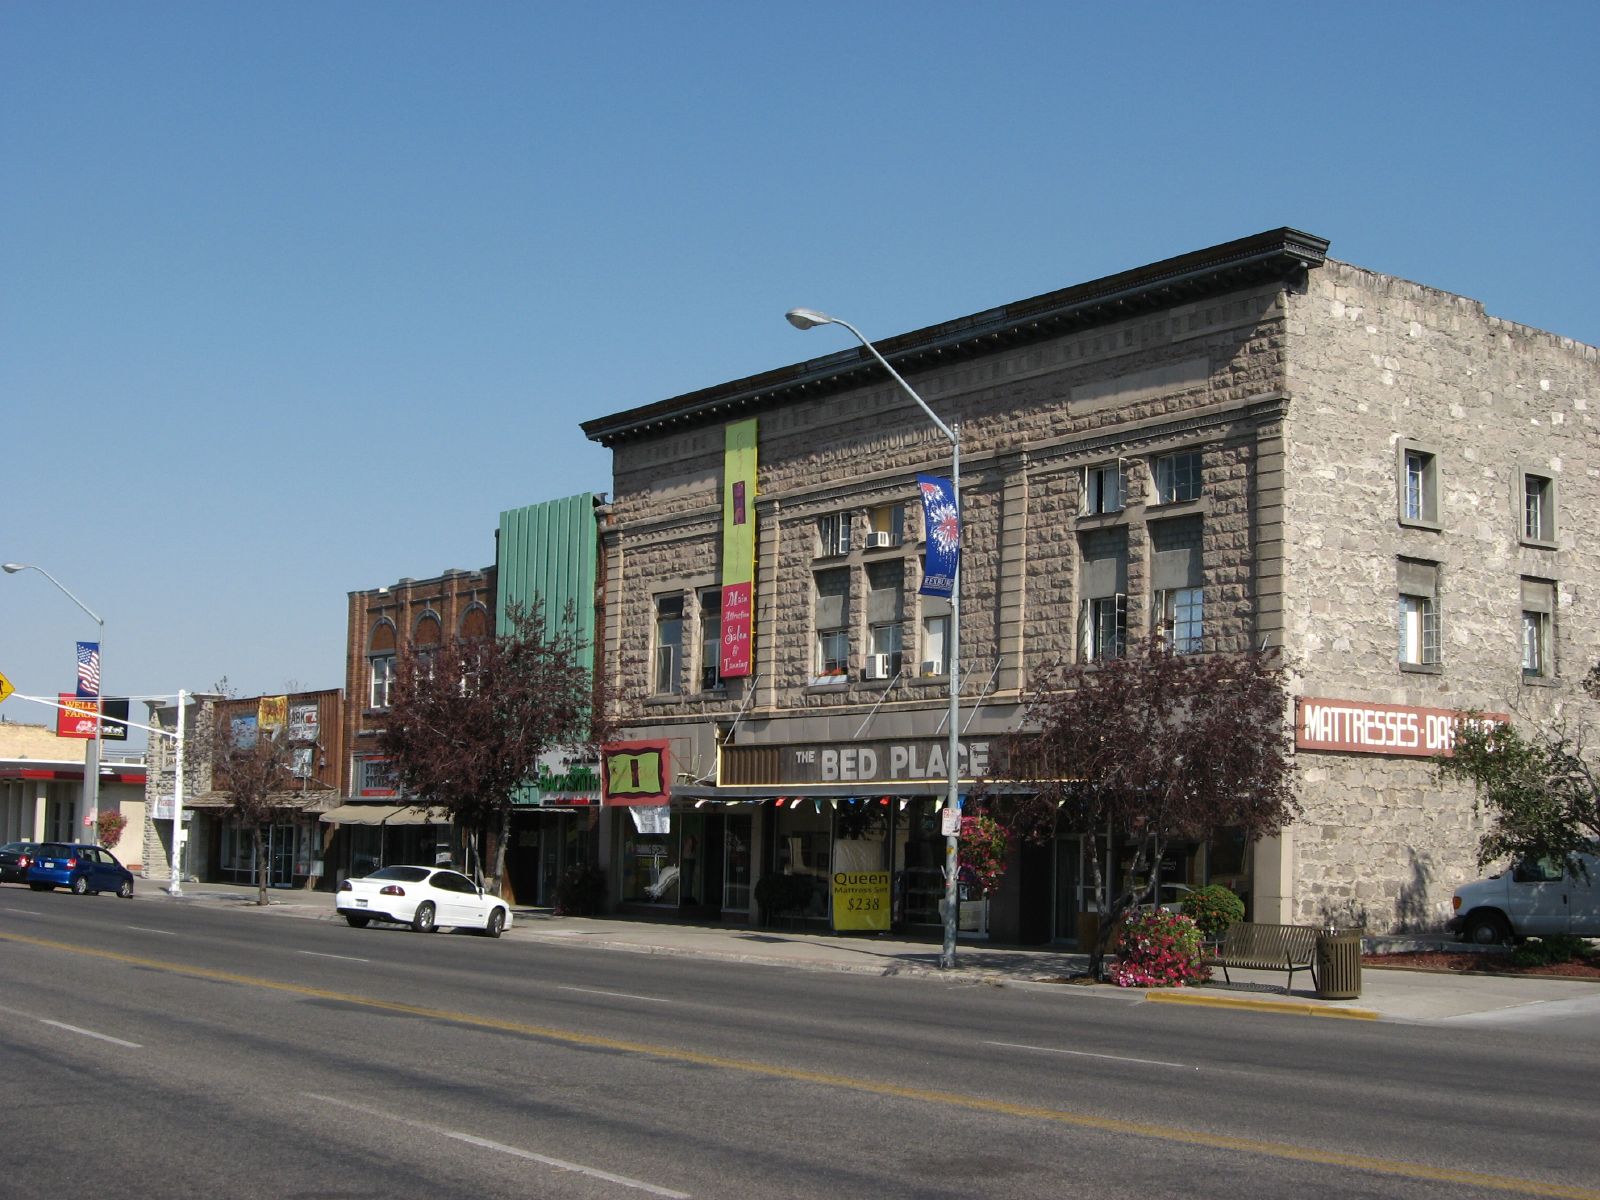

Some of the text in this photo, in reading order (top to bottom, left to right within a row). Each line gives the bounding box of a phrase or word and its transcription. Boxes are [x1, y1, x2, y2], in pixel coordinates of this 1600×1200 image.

[726, 591, 748, 607] Main
[725, 625, 747, 645] Salon
[731, 645, 740, 656] &
[723, 658, 749, 672] Tanning
[795, 742, 989, 781] THE BED PLACE
[834, 872, 888, 886] Queen
[847, 897, 880, 912] $238
